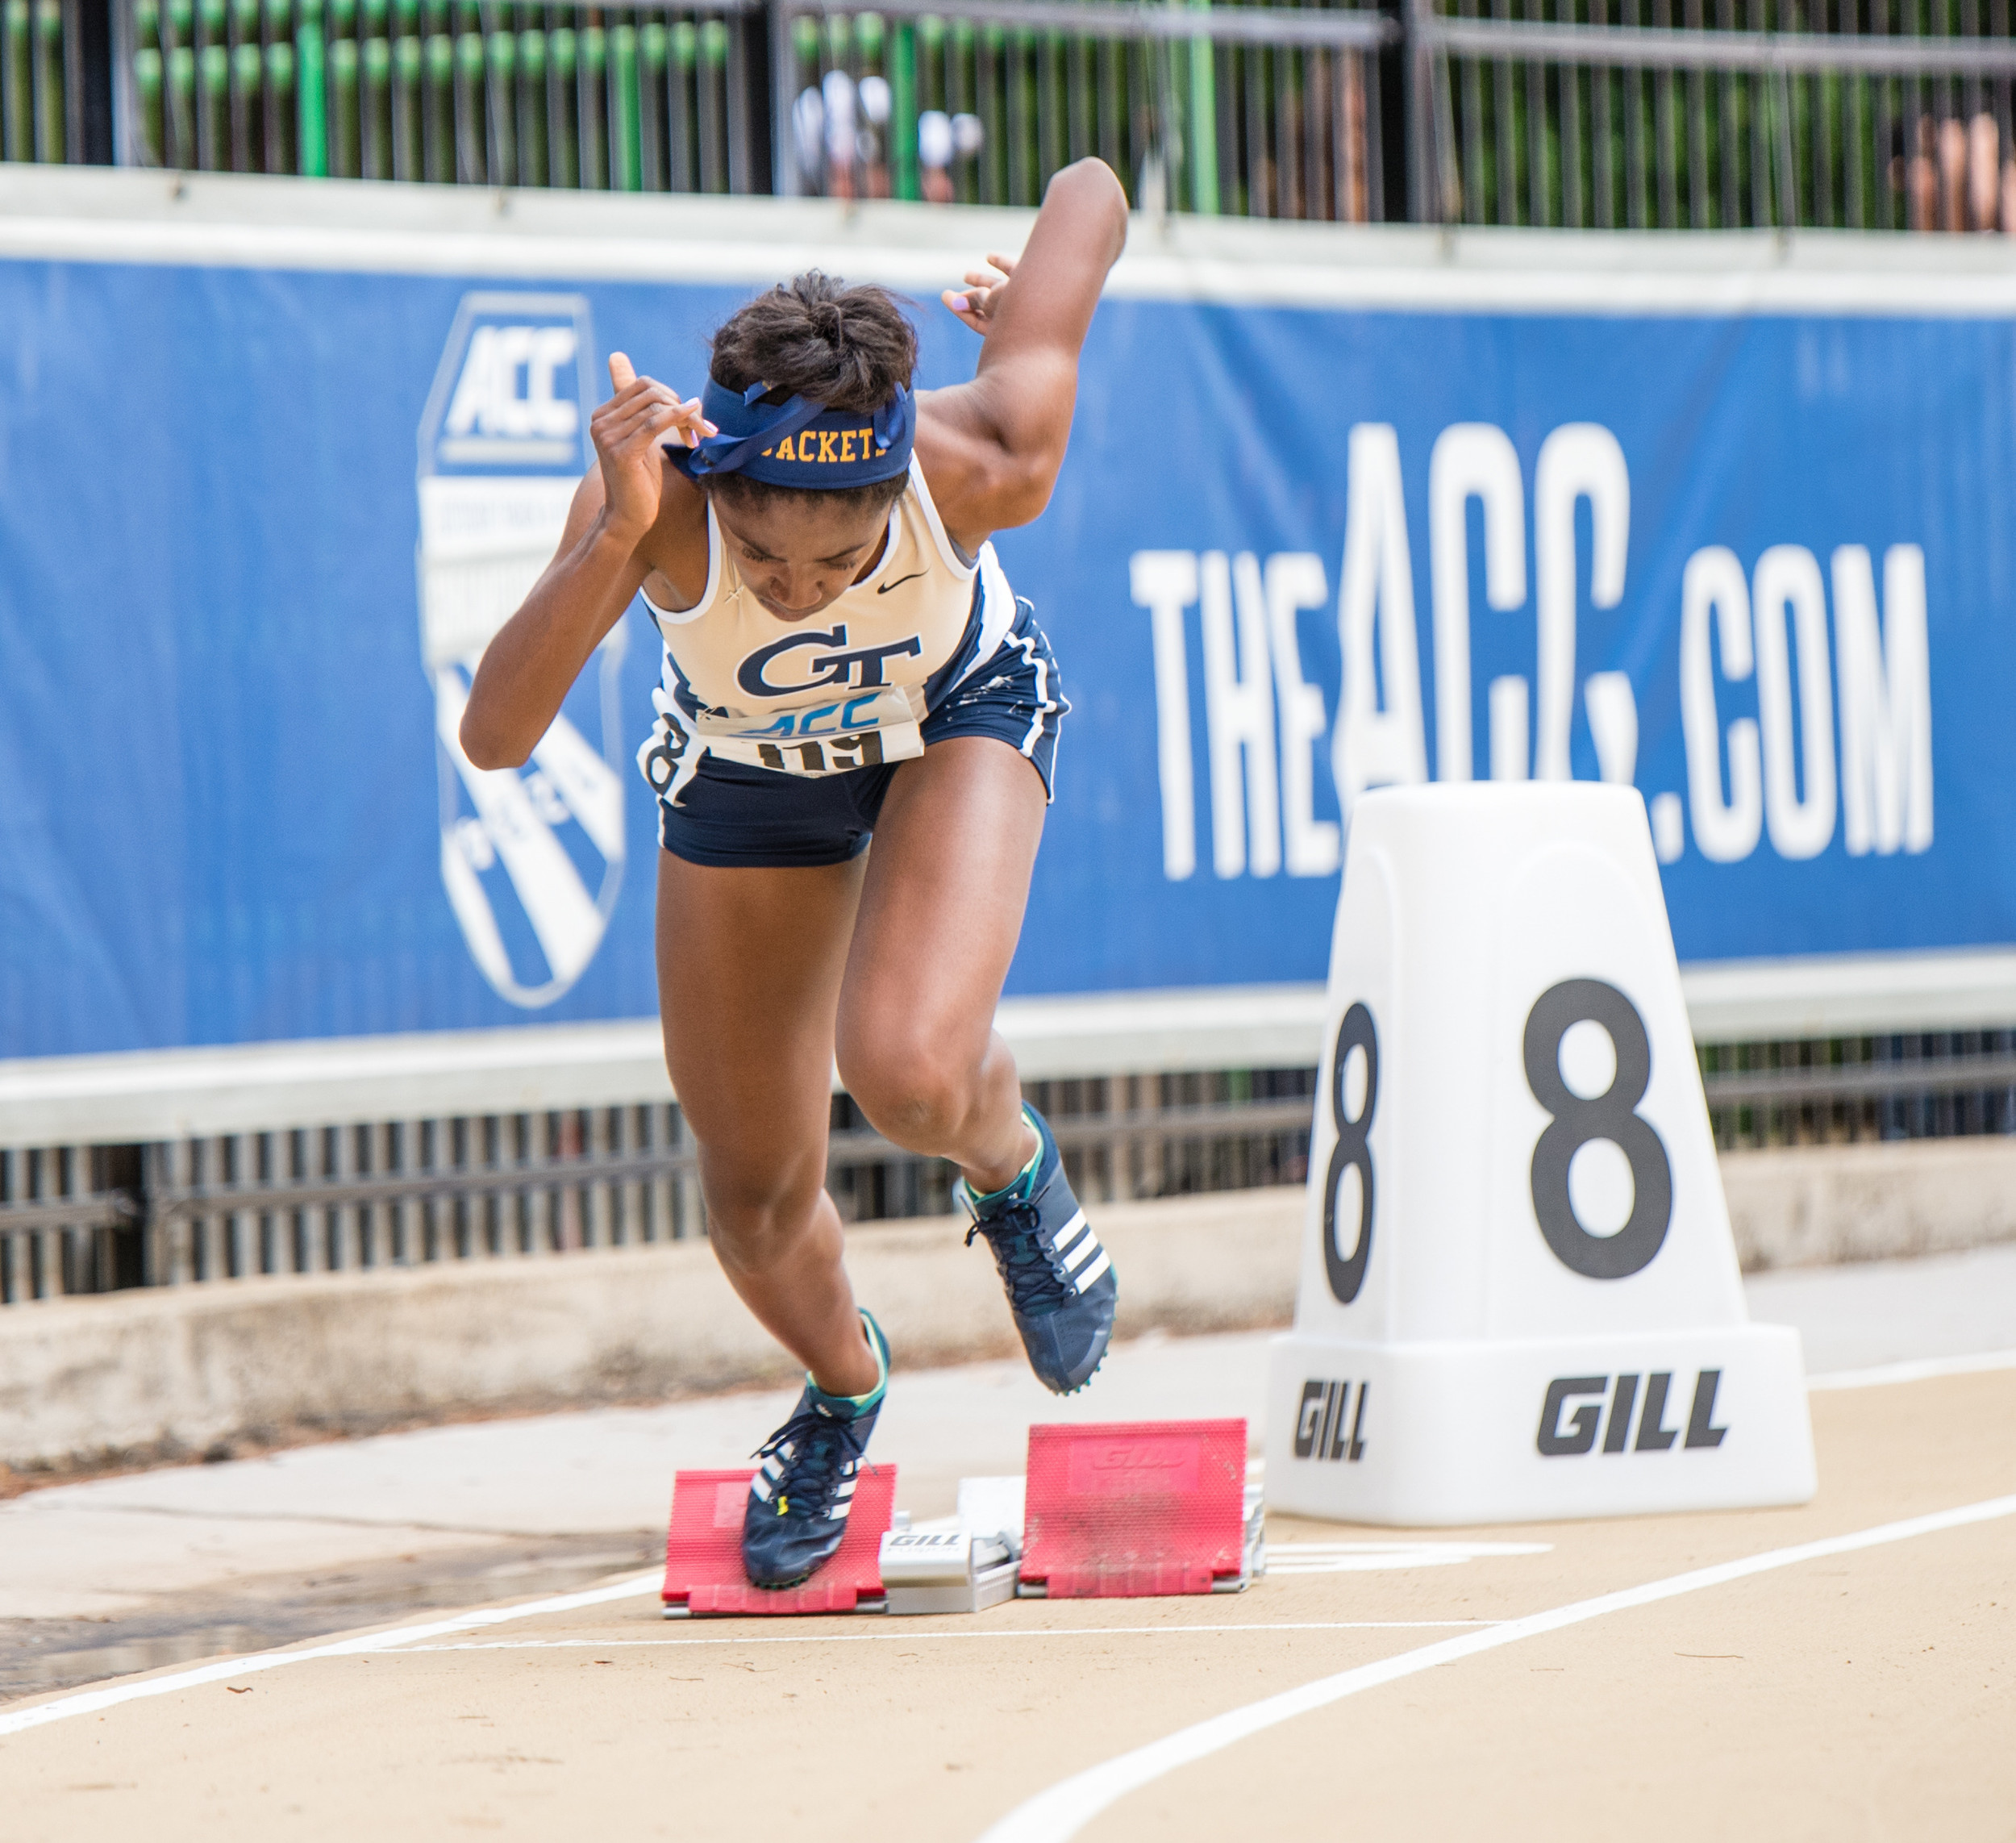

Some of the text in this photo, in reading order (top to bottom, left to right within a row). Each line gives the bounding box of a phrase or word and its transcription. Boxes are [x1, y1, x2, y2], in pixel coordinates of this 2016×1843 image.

[445, 325, 578, 437] ACC
[761, 427, 887, 463] ACKET
[734, 621, 923, 699] GT
[739, 691, 883, 736] ACC
[1322, 1000, 1381, 1304] 8
[1523, 977, 1673, 1281] 8
[1293, 1379, 1368, 1462] GILL
[1536, 1369, 1729, 1457] GILL
[889, 1534, 960, 1546] GILL
